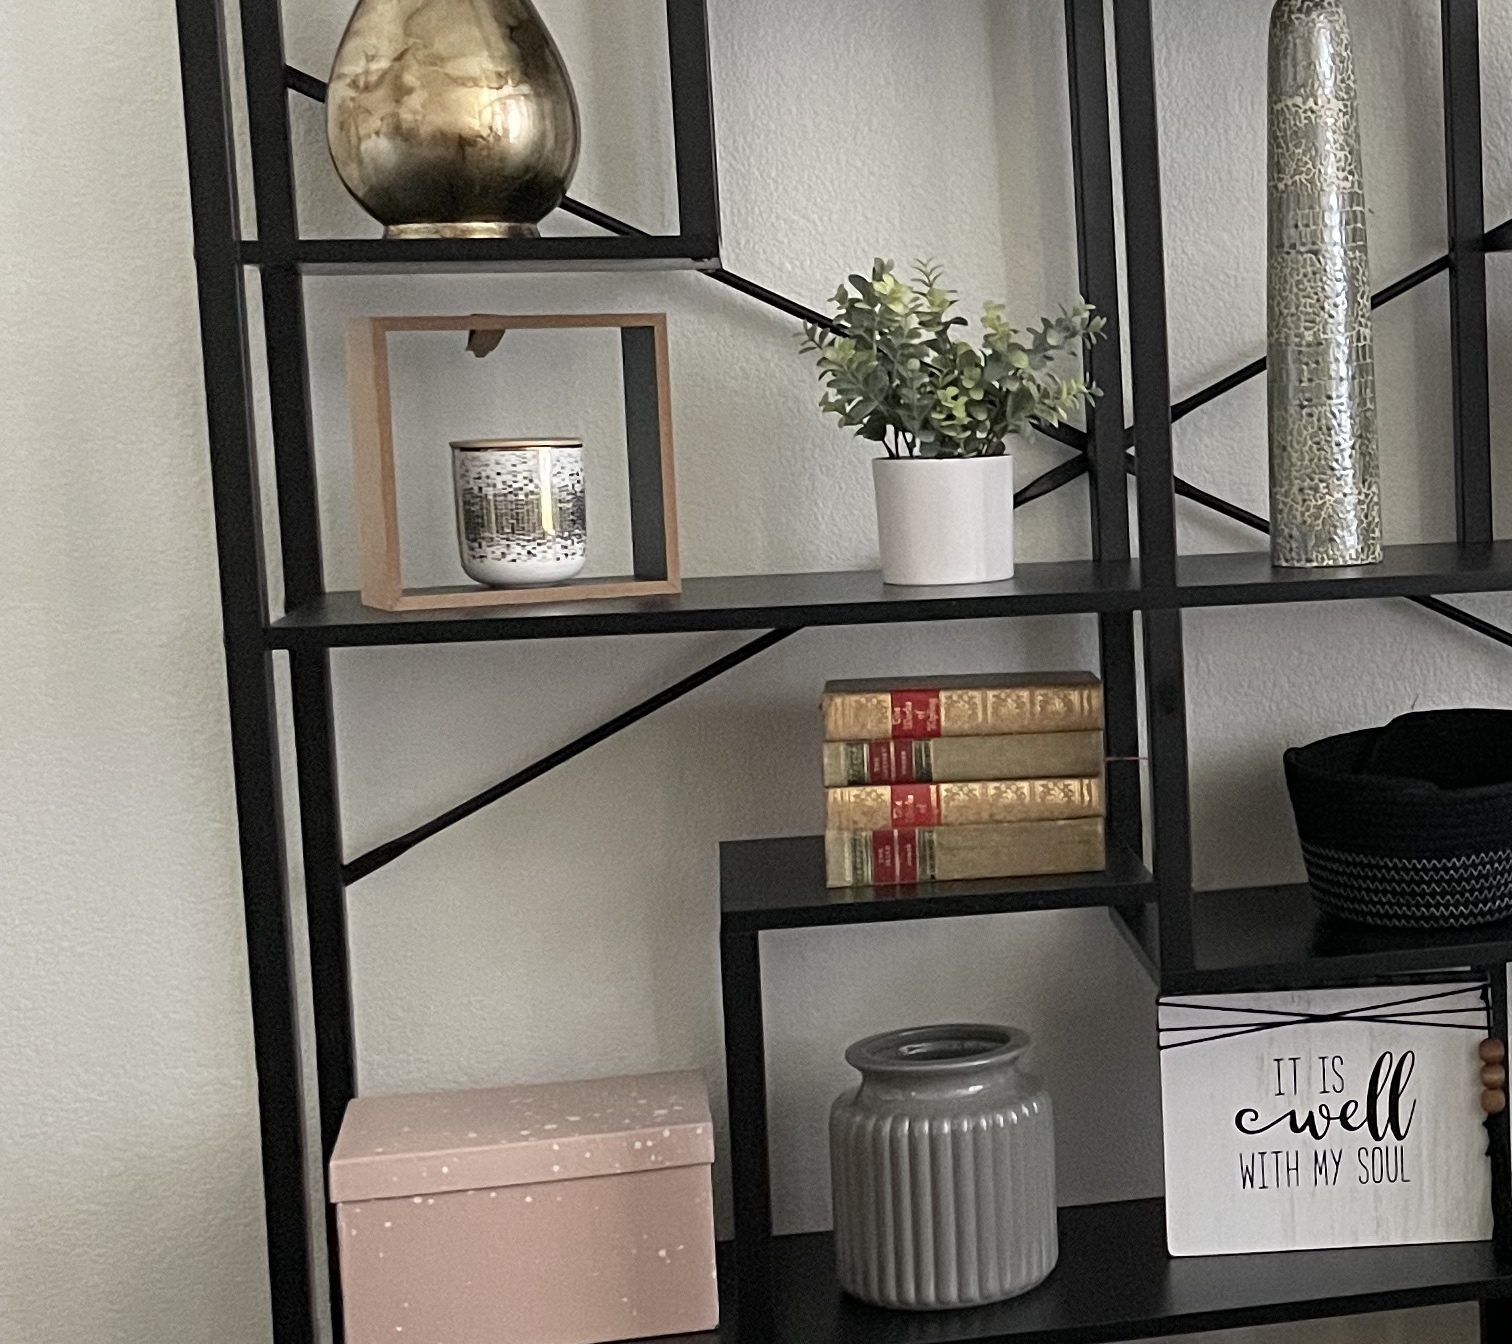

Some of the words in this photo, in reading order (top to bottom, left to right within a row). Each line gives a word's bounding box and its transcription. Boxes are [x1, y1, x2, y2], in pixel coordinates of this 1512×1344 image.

[1234, 1049, 1417, 1142] well
[1273, 1056, 1301, 1096] IT
[1318, 1055, 1345, 1094] IS
[1239, 1149, 1300, 1190] WITH
[1313, 1147, 1343, 1187] MY
[1357, 1145, 1411, 1185] SOUL
